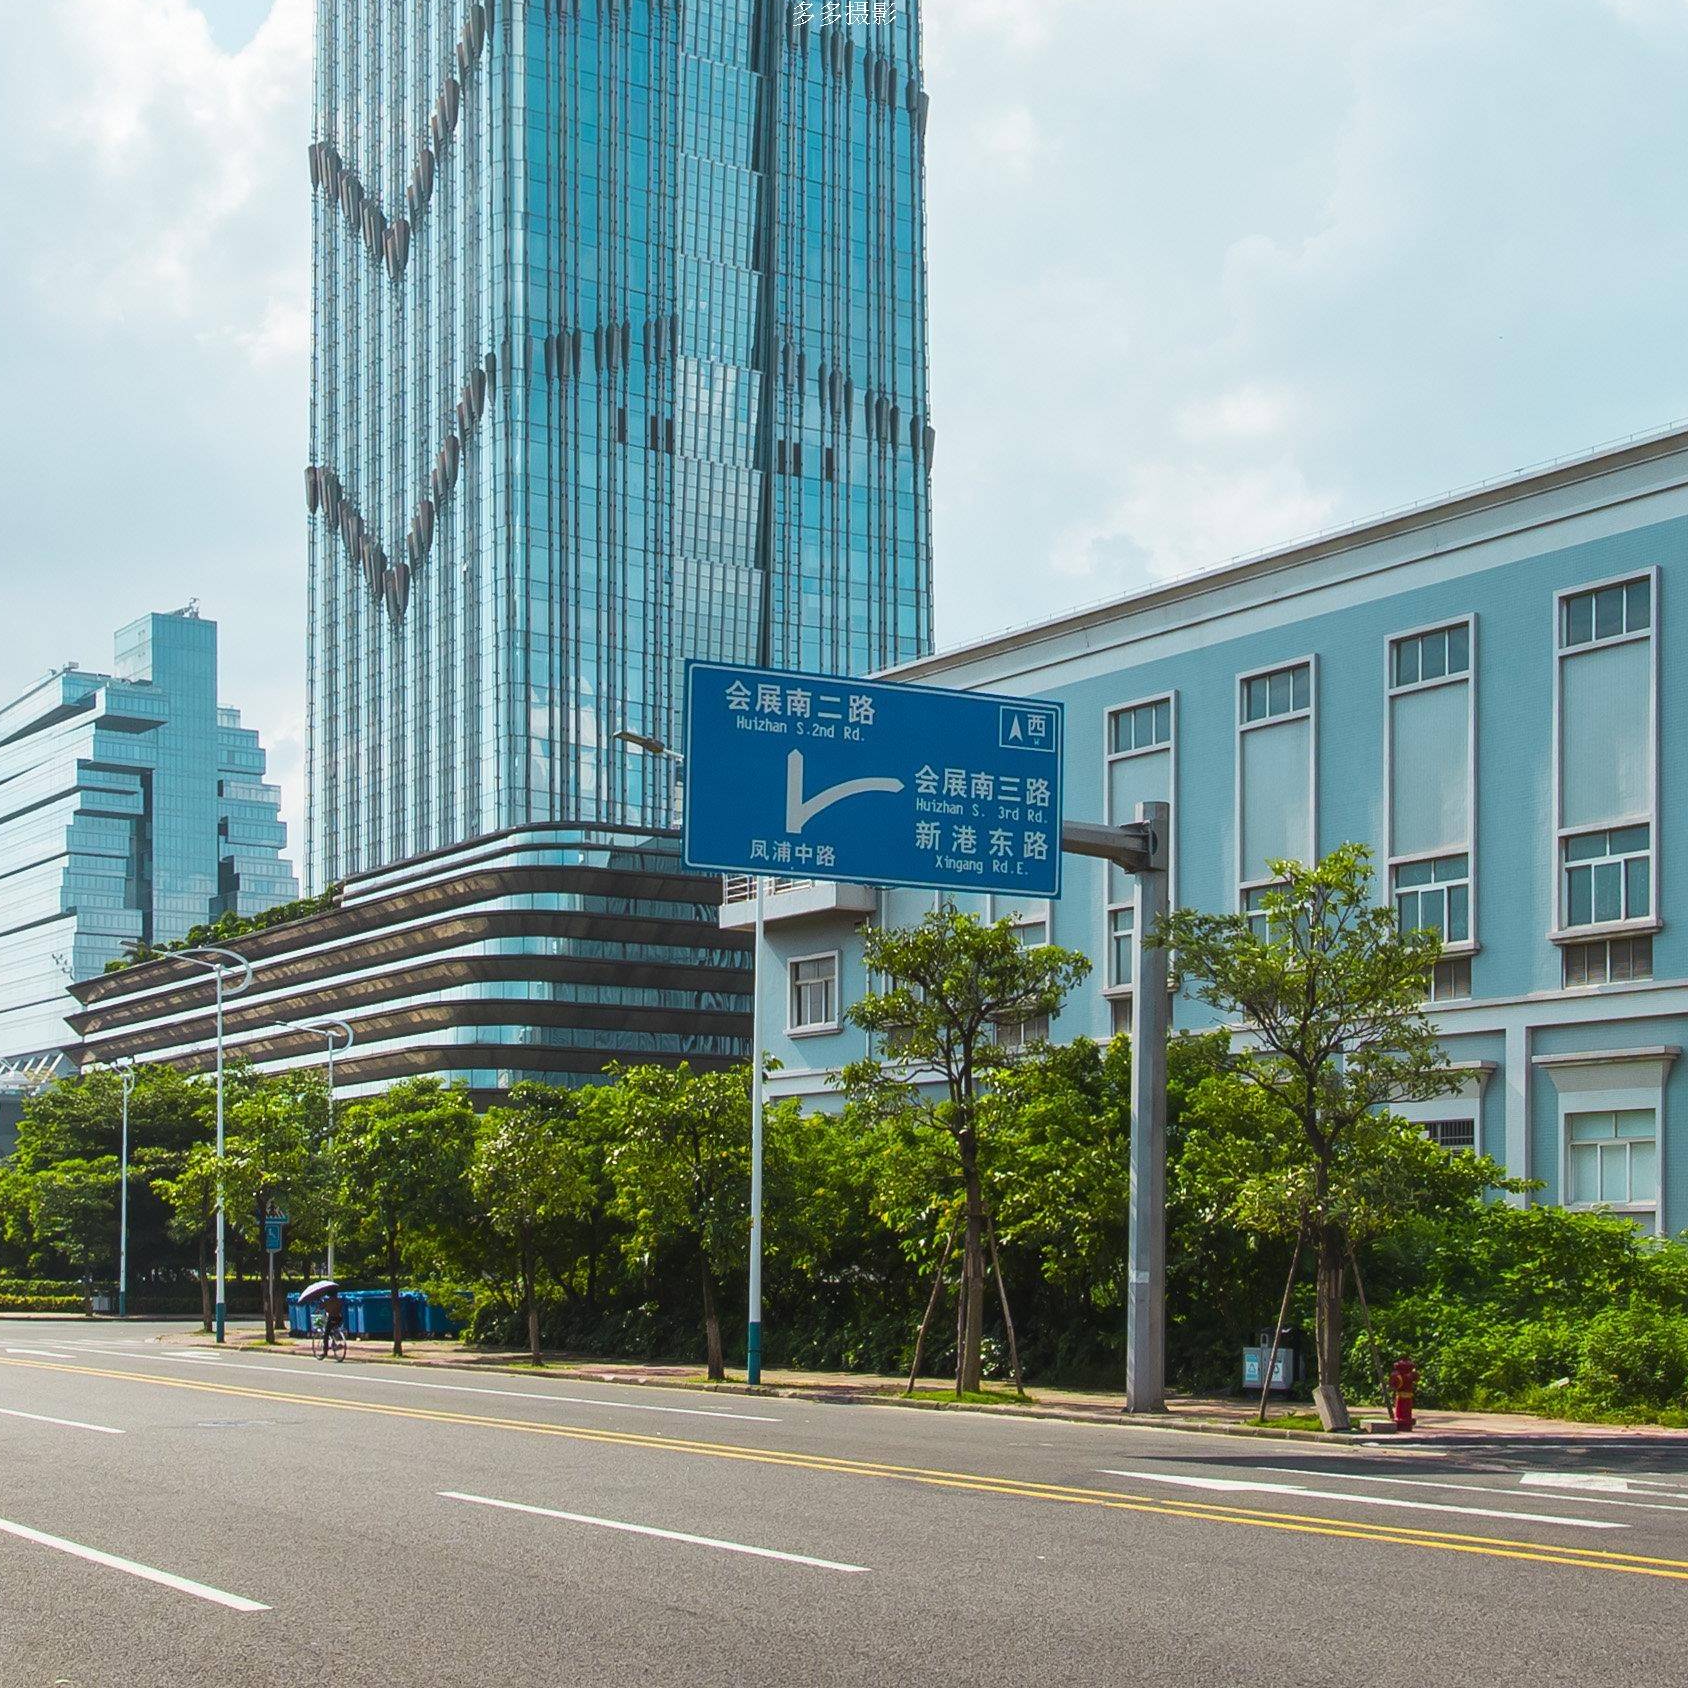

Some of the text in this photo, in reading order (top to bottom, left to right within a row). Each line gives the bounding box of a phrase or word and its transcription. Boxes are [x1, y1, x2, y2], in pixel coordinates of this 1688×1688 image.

[725, 679, 876, 726] 会展南二路
[736, 715, 787, 734] Huizhan
[843, 726, 865, 742] Rd.
[1027, 714, 1046, 738] 西
[914, 764, 1051, 807] 会展南三路
[916, 797, 1049, 824] Huizhan S. 3rd Rd.
[750, 839, 836, 867] 凤浦中路
[915, 820, 1049, 860] 新港东路
[935, 854, 984, 874] Xingang
